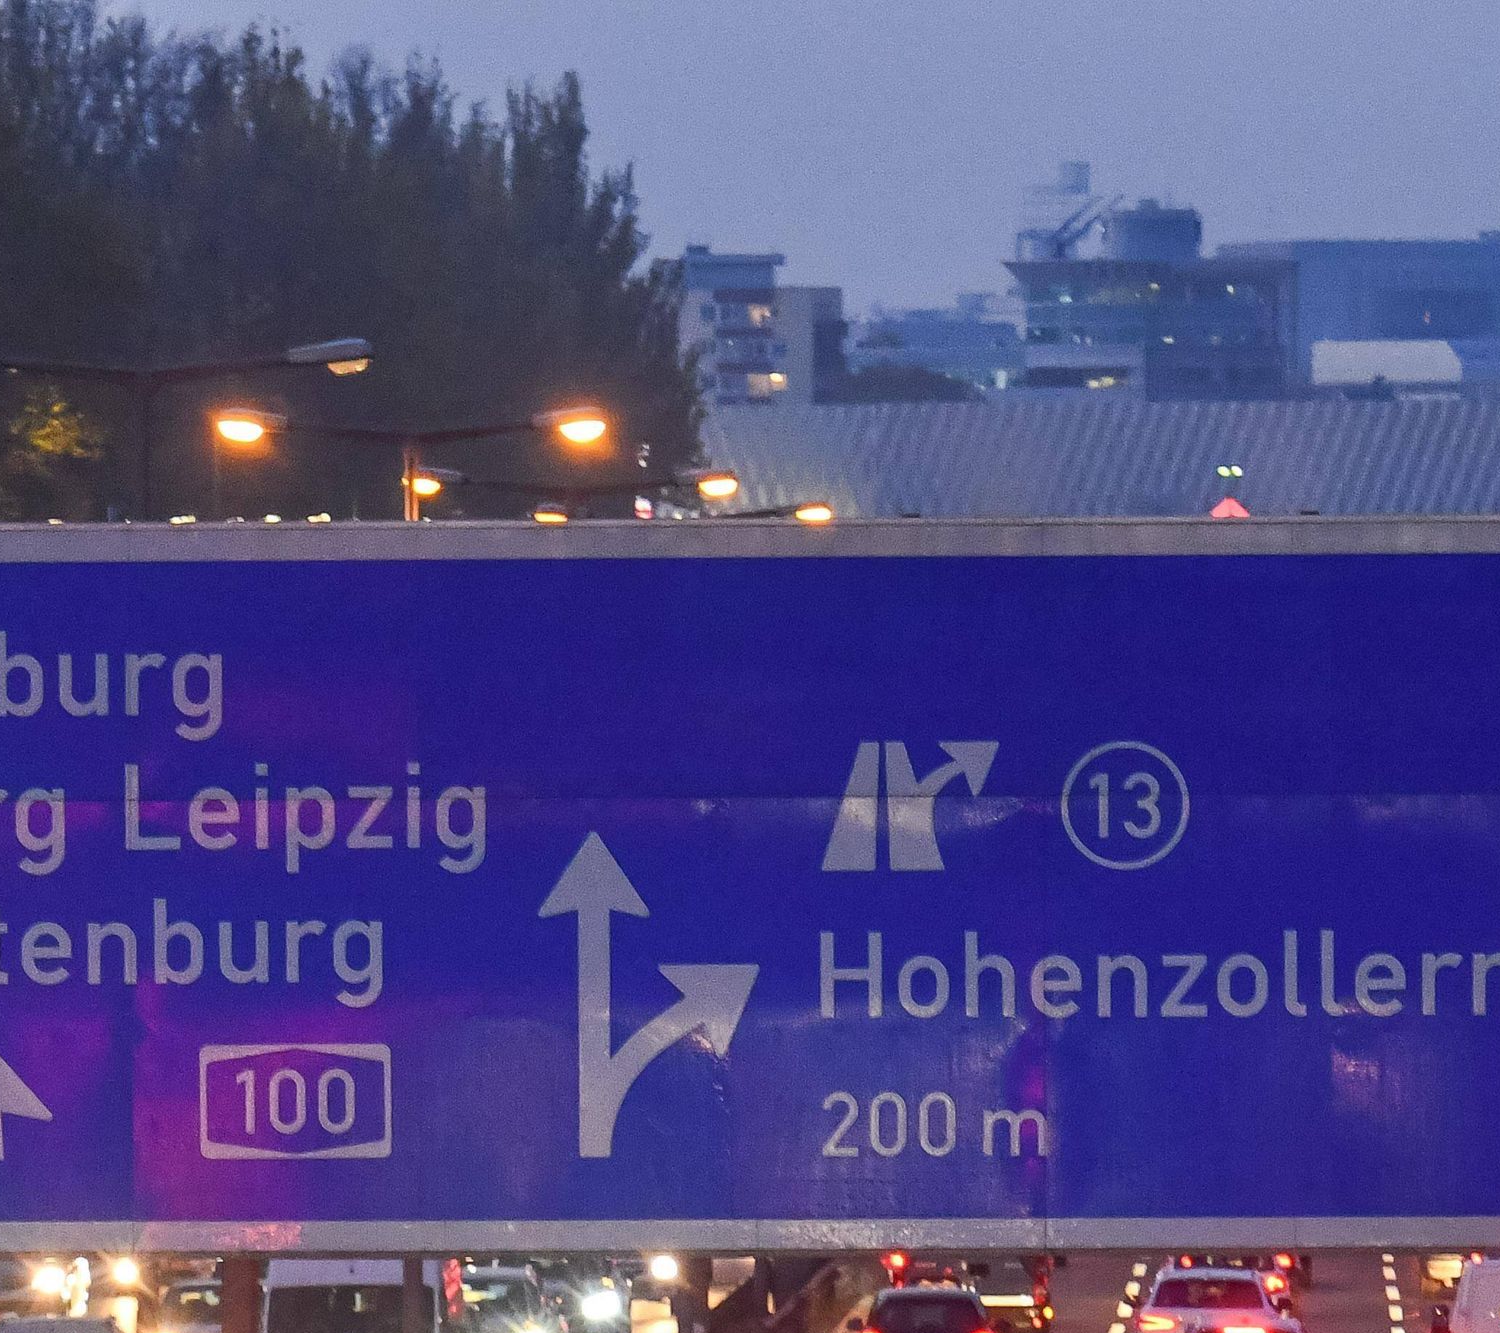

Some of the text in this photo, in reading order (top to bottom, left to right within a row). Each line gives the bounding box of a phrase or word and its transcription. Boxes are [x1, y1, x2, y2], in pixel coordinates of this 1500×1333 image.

[124, 762, 489, 873] Leipzig
[1084, 771, 1163, 841] 13
[234, 1066, 356, 1135] 100
[821, 1092, 1049, 1158] 200 m
